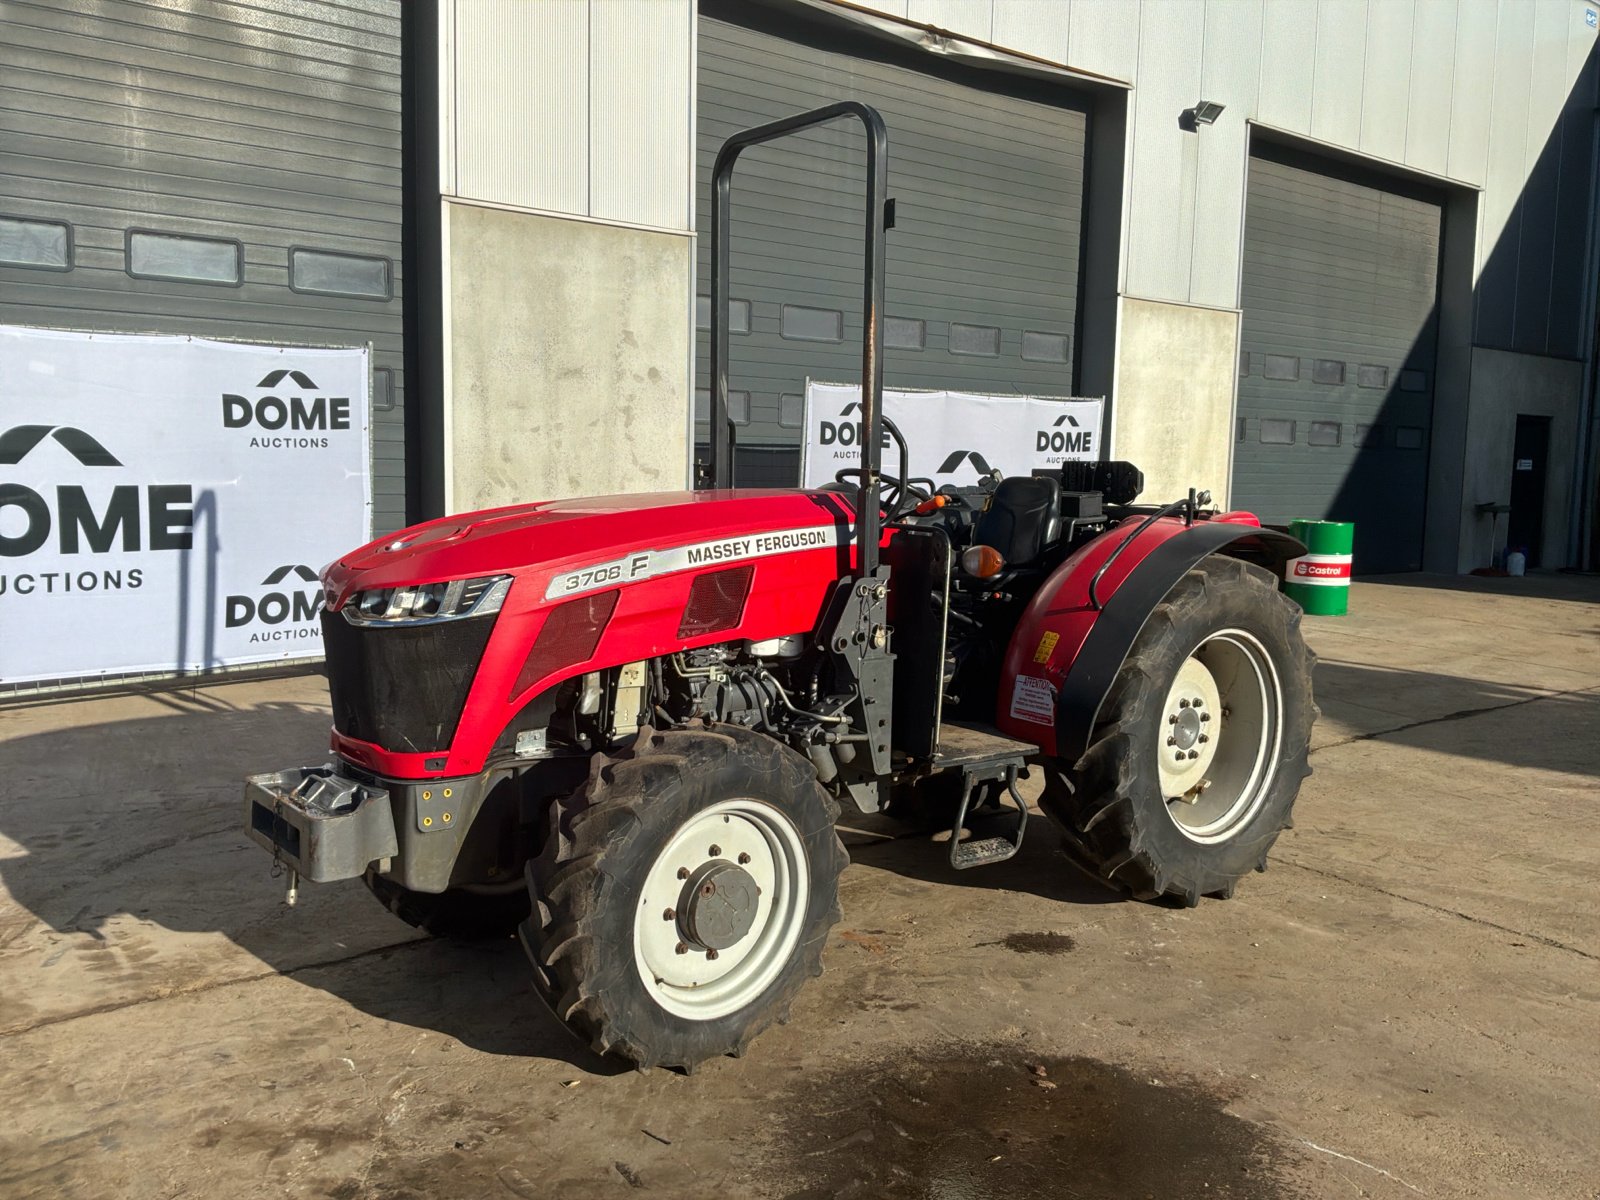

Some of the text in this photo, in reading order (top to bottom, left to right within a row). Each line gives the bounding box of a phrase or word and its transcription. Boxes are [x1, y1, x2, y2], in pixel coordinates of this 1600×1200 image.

[222, 394, 350, 431] DOME
[249, 437, 329, 449] AUCTIONS
[820, 421, 891, 448] DOE
[1036, 431, 1092, 452] DOME
[833, 451, 862, 459] AUCTI
[0, 483, 193, 557] OME
[687, 530, 826, 564] MASSEY FERGUSON
[0, 568, 143, 594] CTIONS
[566, 555, 649, 590] 3708 F
[1308, 566, 1341, 575] Castrol
[225, 589, 325, 628] DOM
[249, 627, 324, 643] AUCTION
